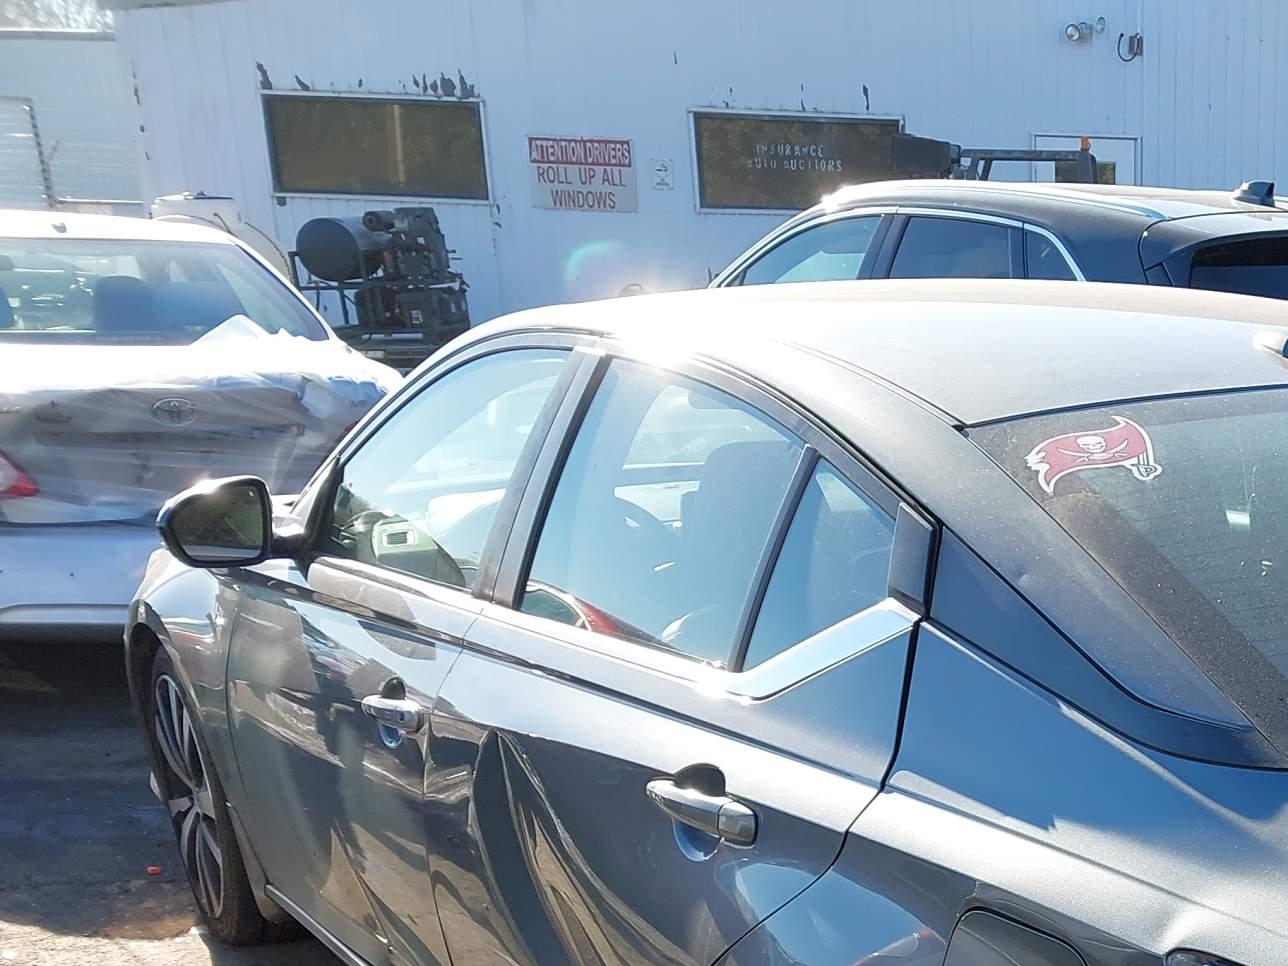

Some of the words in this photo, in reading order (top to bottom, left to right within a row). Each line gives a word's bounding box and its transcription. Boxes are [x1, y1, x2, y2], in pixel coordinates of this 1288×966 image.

[530, 139, 585, 162] ATTENTION
[586, 142, 630, 165] DRIVERS
[536, 166, 573, 184] ROLL
[578, 167, 597, 185] UP
[601, 168, 627, 187] ALL
[550, 189, 617, 209] WINDOWS
